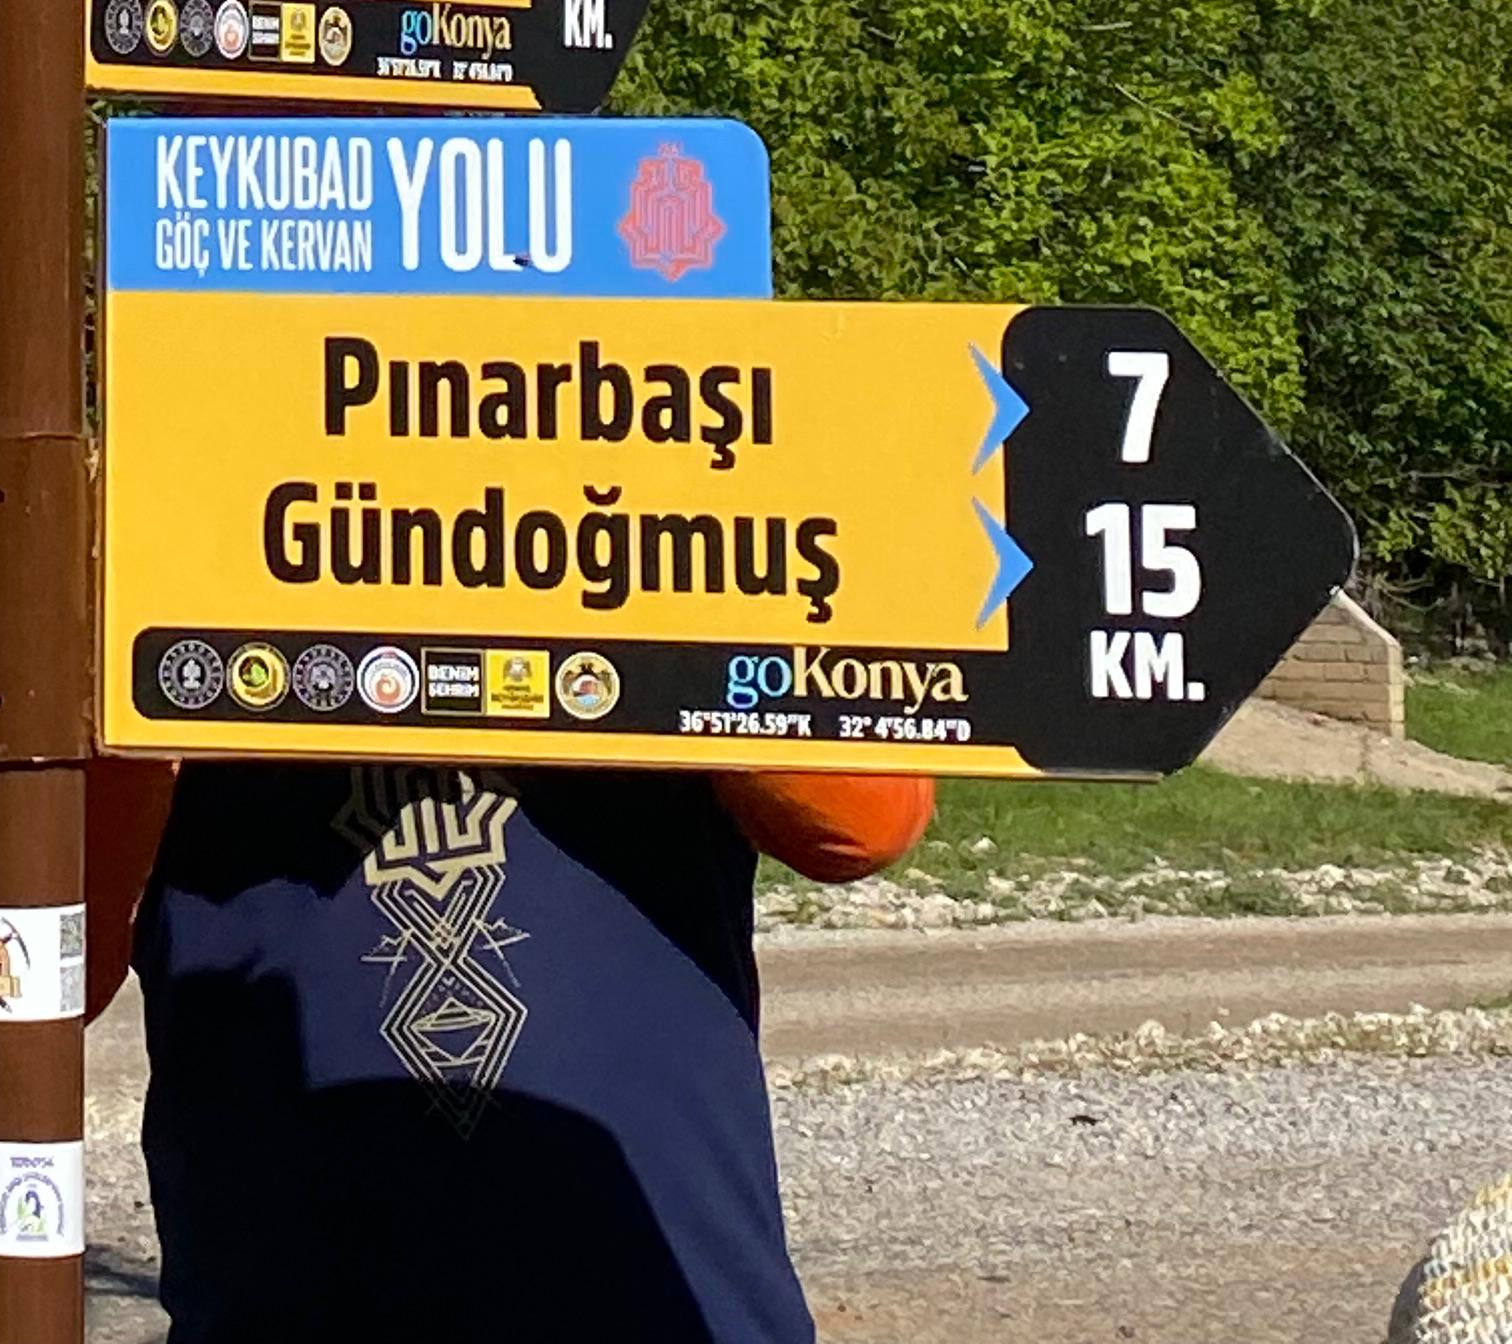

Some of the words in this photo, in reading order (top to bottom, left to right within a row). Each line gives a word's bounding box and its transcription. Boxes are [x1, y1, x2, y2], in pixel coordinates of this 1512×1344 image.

[400, 2, 512, 60] goKonya
[156, 135, 372, 210] KEYKUBAD
[386, 136, 573, 273] YOLU
[156, 211, 209, 278] GÖÇ
[218, 218, 253, 271] VE
[261, 218, 372, 273] KERVAN
[324, 336, 773, 470] Pınarbaşı
[1107, 351, 1170, 464] 7
[264, 481, 841, 624] Gündoğmuş
[1086, 503, 1202, 619] 15
[726, 645, 969, 715] goKonya
[1089, 630, 1206, 701] KM.
